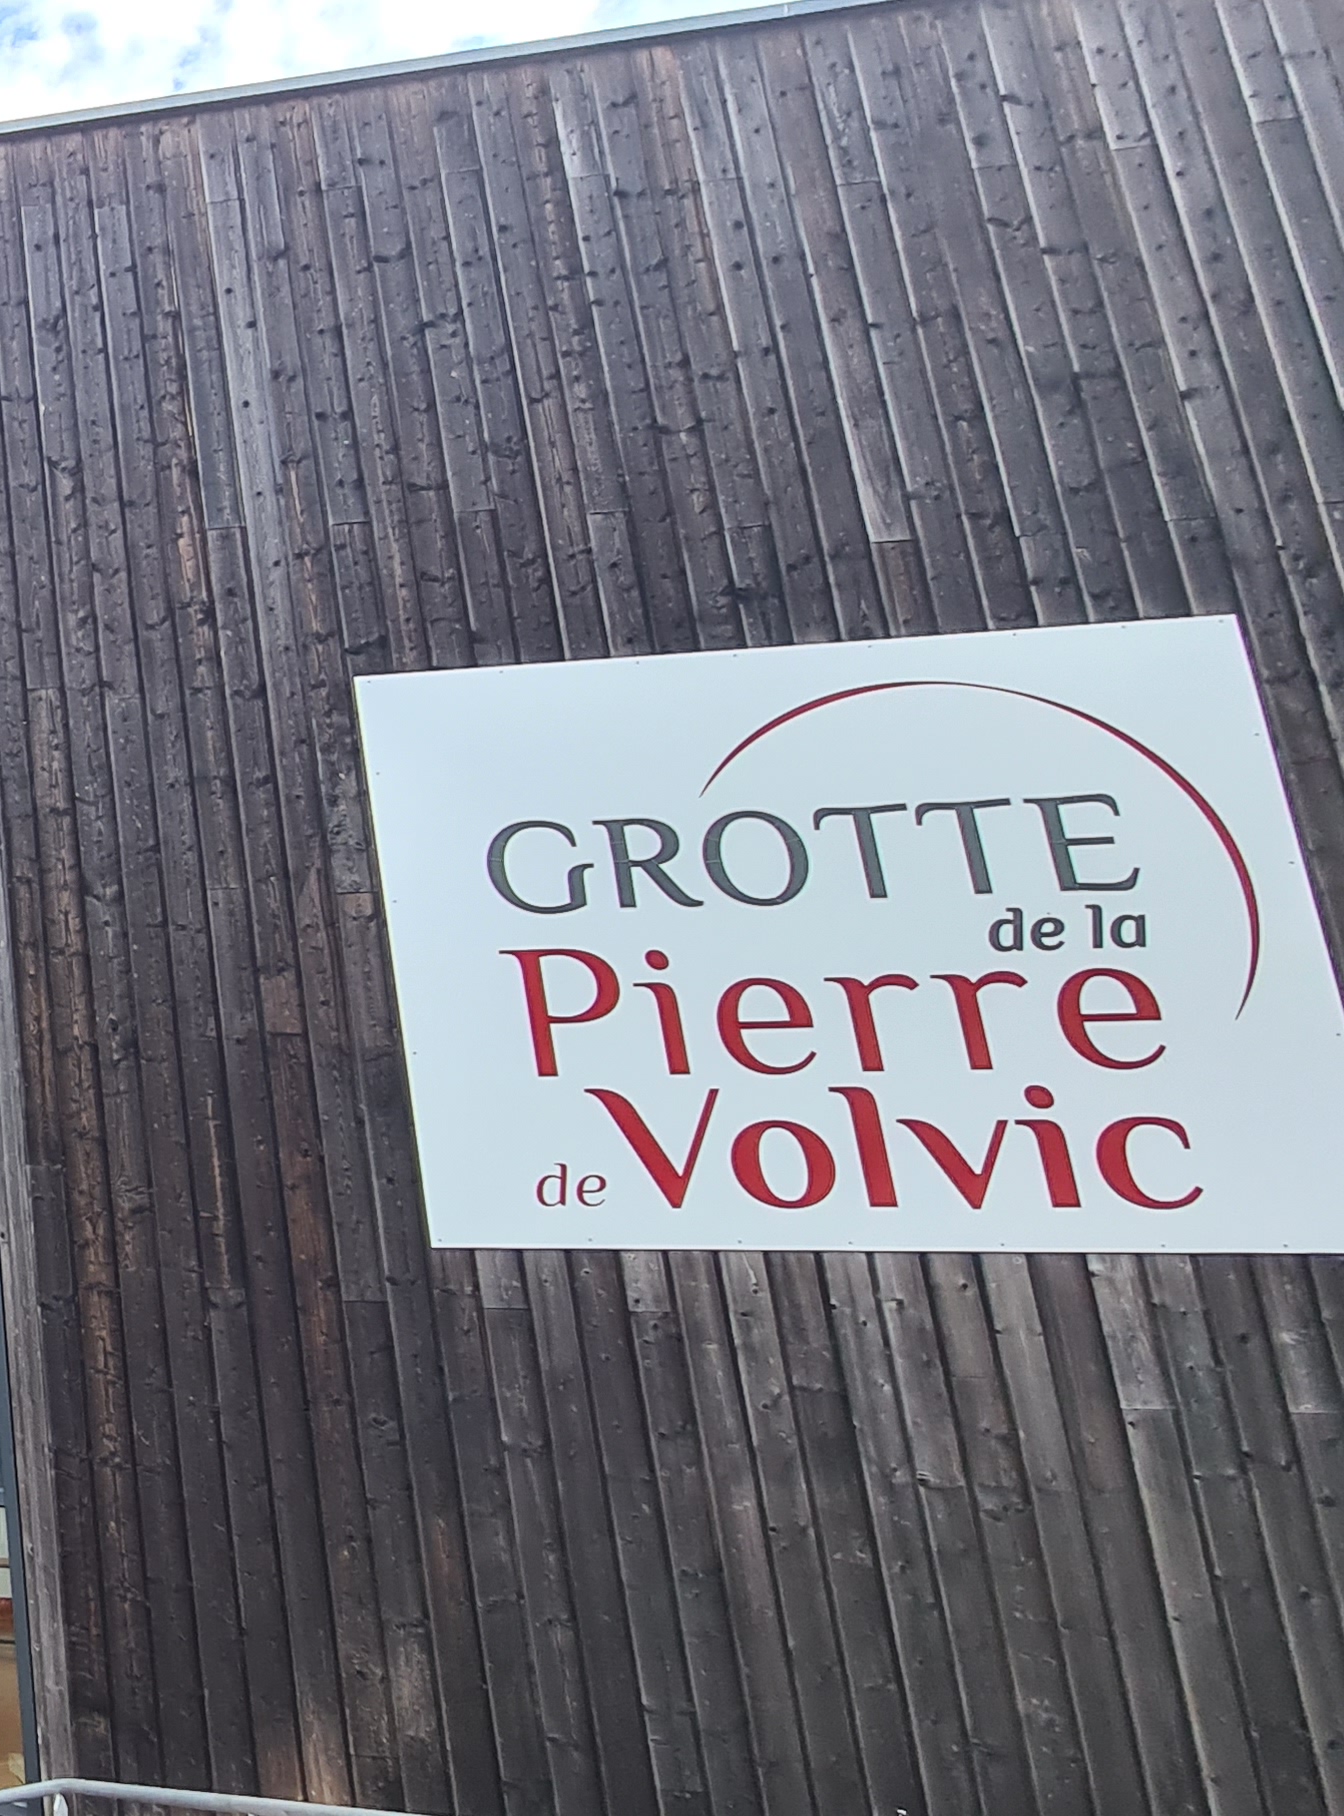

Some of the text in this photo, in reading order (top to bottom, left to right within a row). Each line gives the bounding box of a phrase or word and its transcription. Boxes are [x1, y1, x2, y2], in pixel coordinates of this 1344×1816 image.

[486, 793, 1142, 915] GROTTE
[988, 904, 1148, 952] de la
[498, 948, 1167, 1078] Pierre
[534, 1085, 1205, 1210] de Volvic
